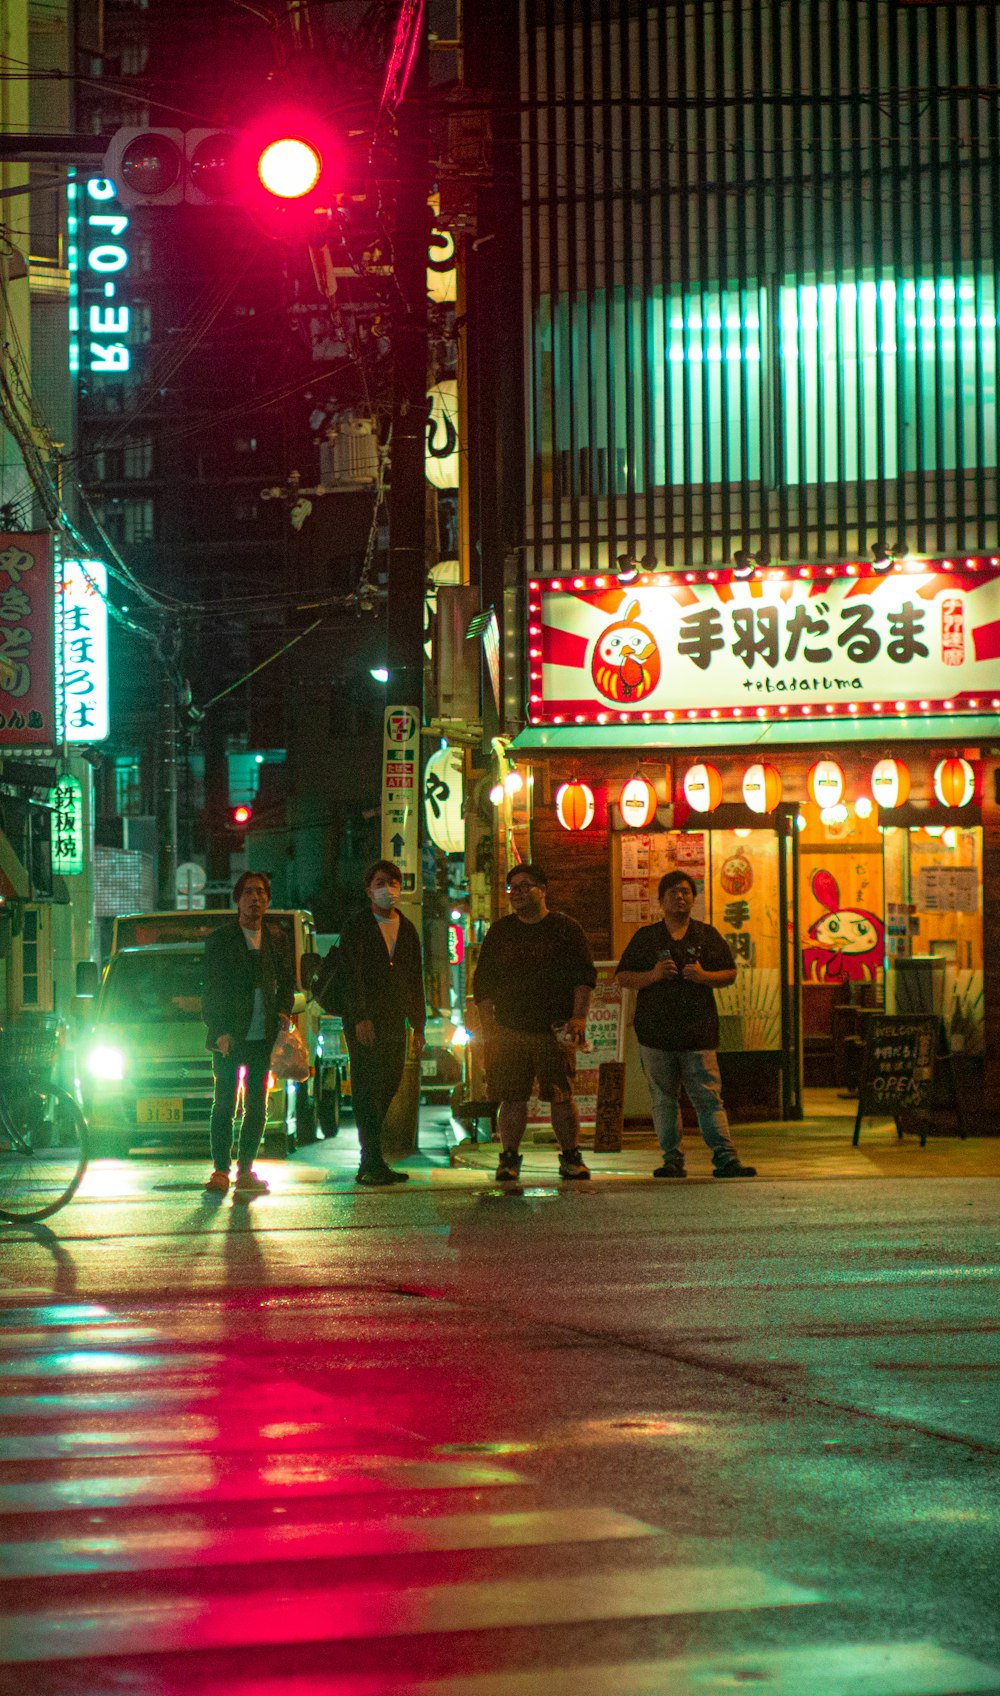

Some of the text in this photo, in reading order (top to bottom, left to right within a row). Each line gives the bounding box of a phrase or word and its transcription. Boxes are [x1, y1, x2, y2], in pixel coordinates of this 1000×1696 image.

[677, 600, 929, 670] 手羽だるま
[64, 604, 97, 728] まほろば
[742, 675, 864, 692] tebadaruma
[388, 777, 411, 787] ATM
[53, 787, 78, 859] 鉄板焼
[872, 1075, 921, 1092] OPEN
